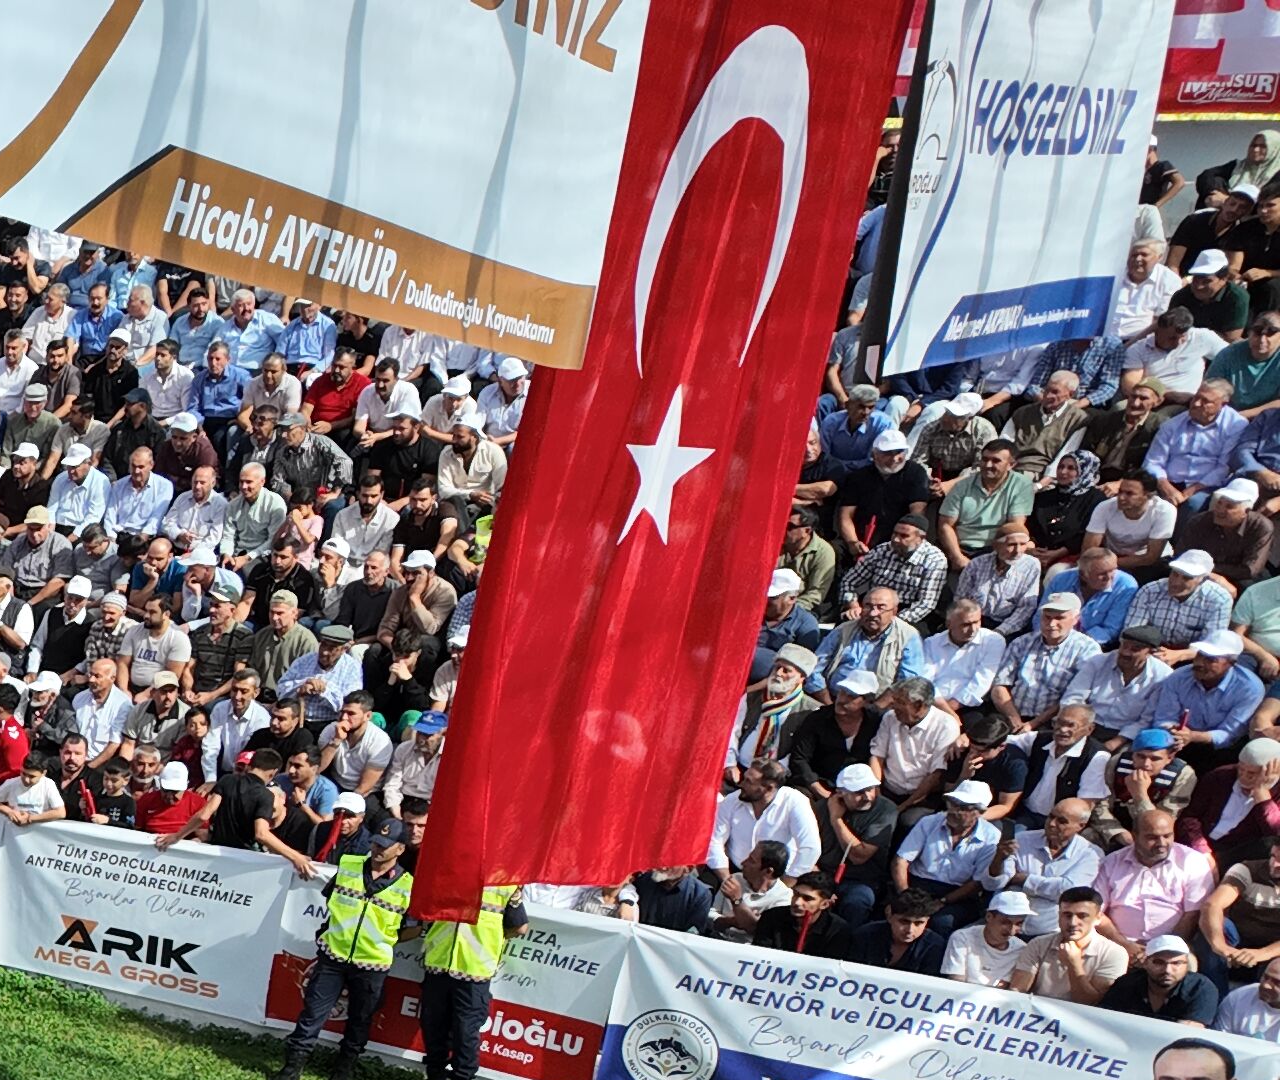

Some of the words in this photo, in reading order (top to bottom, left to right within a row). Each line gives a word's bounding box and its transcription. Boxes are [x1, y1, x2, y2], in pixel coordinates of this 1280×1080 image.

[163, 178, 273, 259] Hicabi
[269, 214, 398, 298] AYTEMÜR
[405, 279, 484, 328] Dulkadiroğlu
[485, 304, 555, 344] Kaymakamı
[25, 854, 102, 879] ANTRENÖR
[104, 871, 120, 882] ve
[123, 870, 253, 907] İDARECİLERİMİZE
[57, 843, 87, 860] TÜM
[91, 851, 223, 887] SPORCULARIMIZA,
[145, 894, 205, 919] Dilerim
[54, 918, 202, 975] ARIK
[303, 903, 328, 919] AN
[503, 942, 600, 976] İLERİMİZE
[34, 946, 111, 975] MEGA
[120, 965, 219, 999] GROSS
[676, 974, 824, 1017] ANTRENÖR
[830, 1007, 860, 1024] ve
[866, 1006, 1128, 1079] İDARECİLERİMİZE
[738, 959, 797, 986] TÜM
[801, 972, 1067, 1042] SPORCULARIMIZA,
[493, 1044, 534, 1065] Kasap
